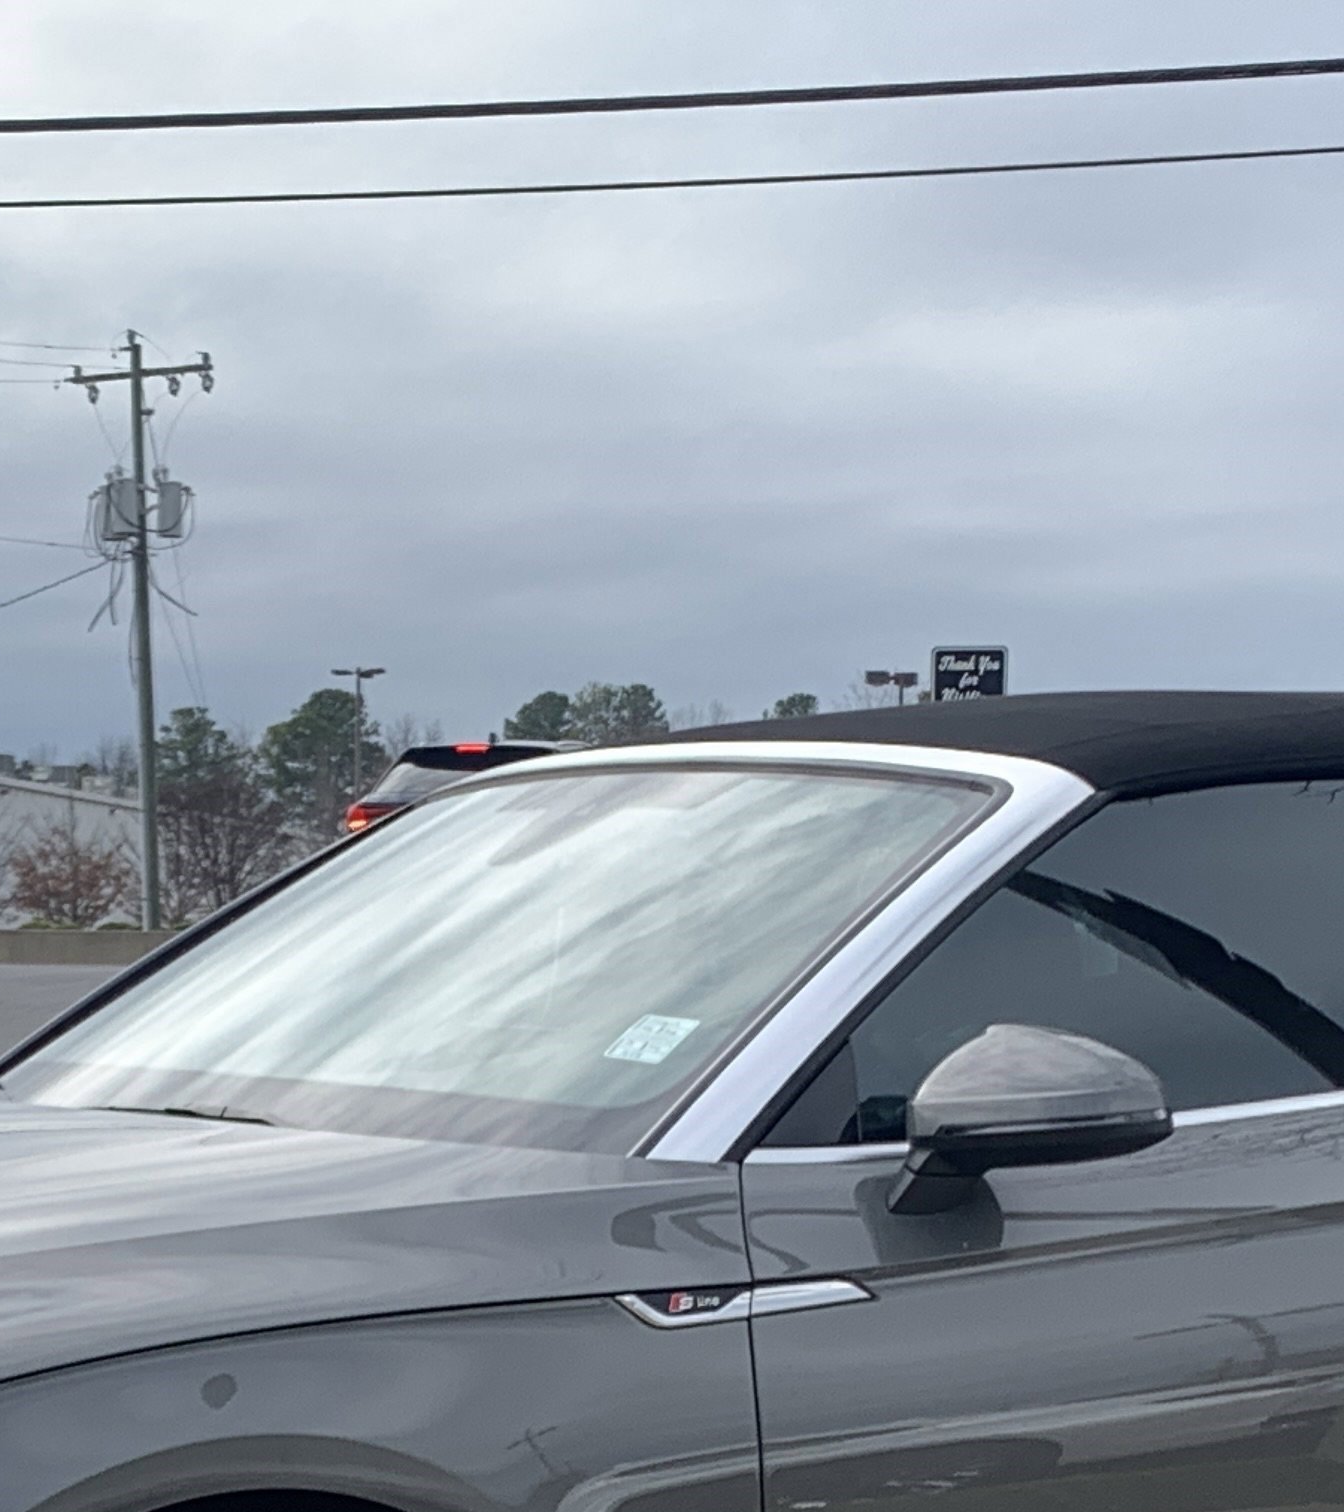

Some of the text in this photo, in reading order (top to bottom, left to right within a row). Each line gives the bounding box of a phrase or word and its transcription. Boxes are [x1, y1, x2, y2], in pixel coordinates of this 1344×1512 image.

[938, 654, 1000, 675] Thank You
[959, 672, 979, 689] for
